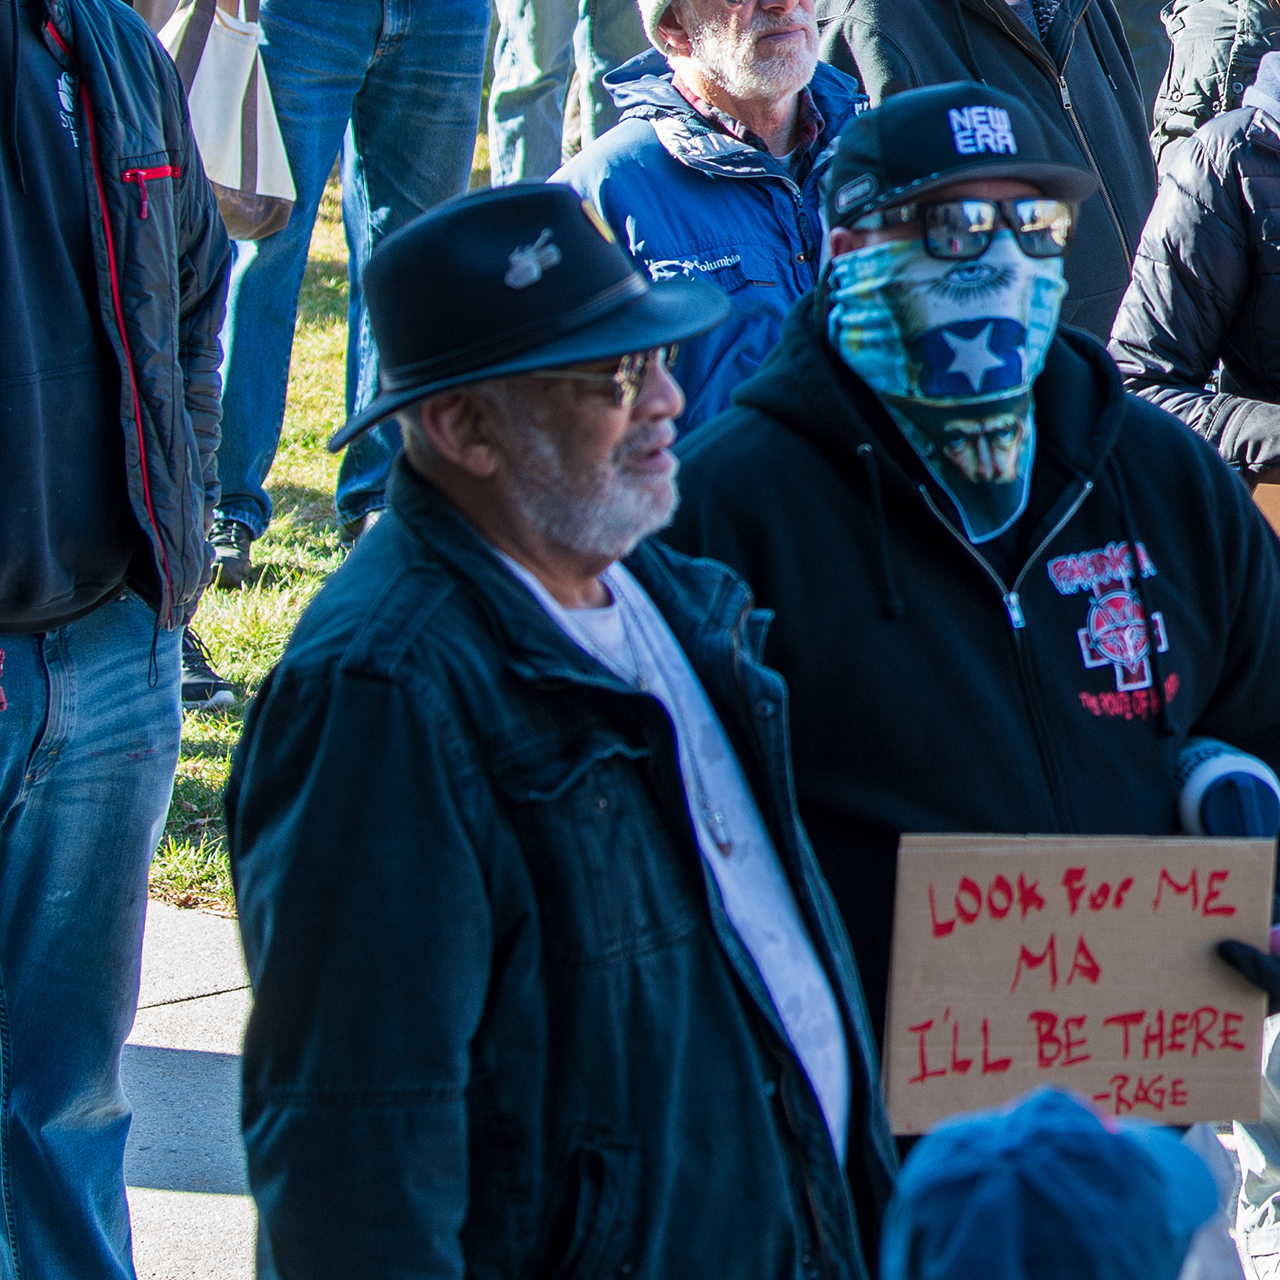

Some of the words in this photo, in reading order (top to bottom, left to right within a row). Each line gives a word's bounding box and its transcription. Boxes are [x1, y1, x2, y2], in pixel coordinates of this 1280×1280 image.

[948, 105, 1012, 132] NEW
[954, 129, 1018, 156] ERA
[694, 254, 741, 272] Columbia
[928, 872, 1045, 938] LOOK
[1153, 867, 1237, 918] ME
[1010, 932, 1102, 994] MA
[907, 1006, 1013, 1084] I'LL
[1028, 1010, 1092, 1070] BE
[1103, 1005, 1246, 1059] THERE
